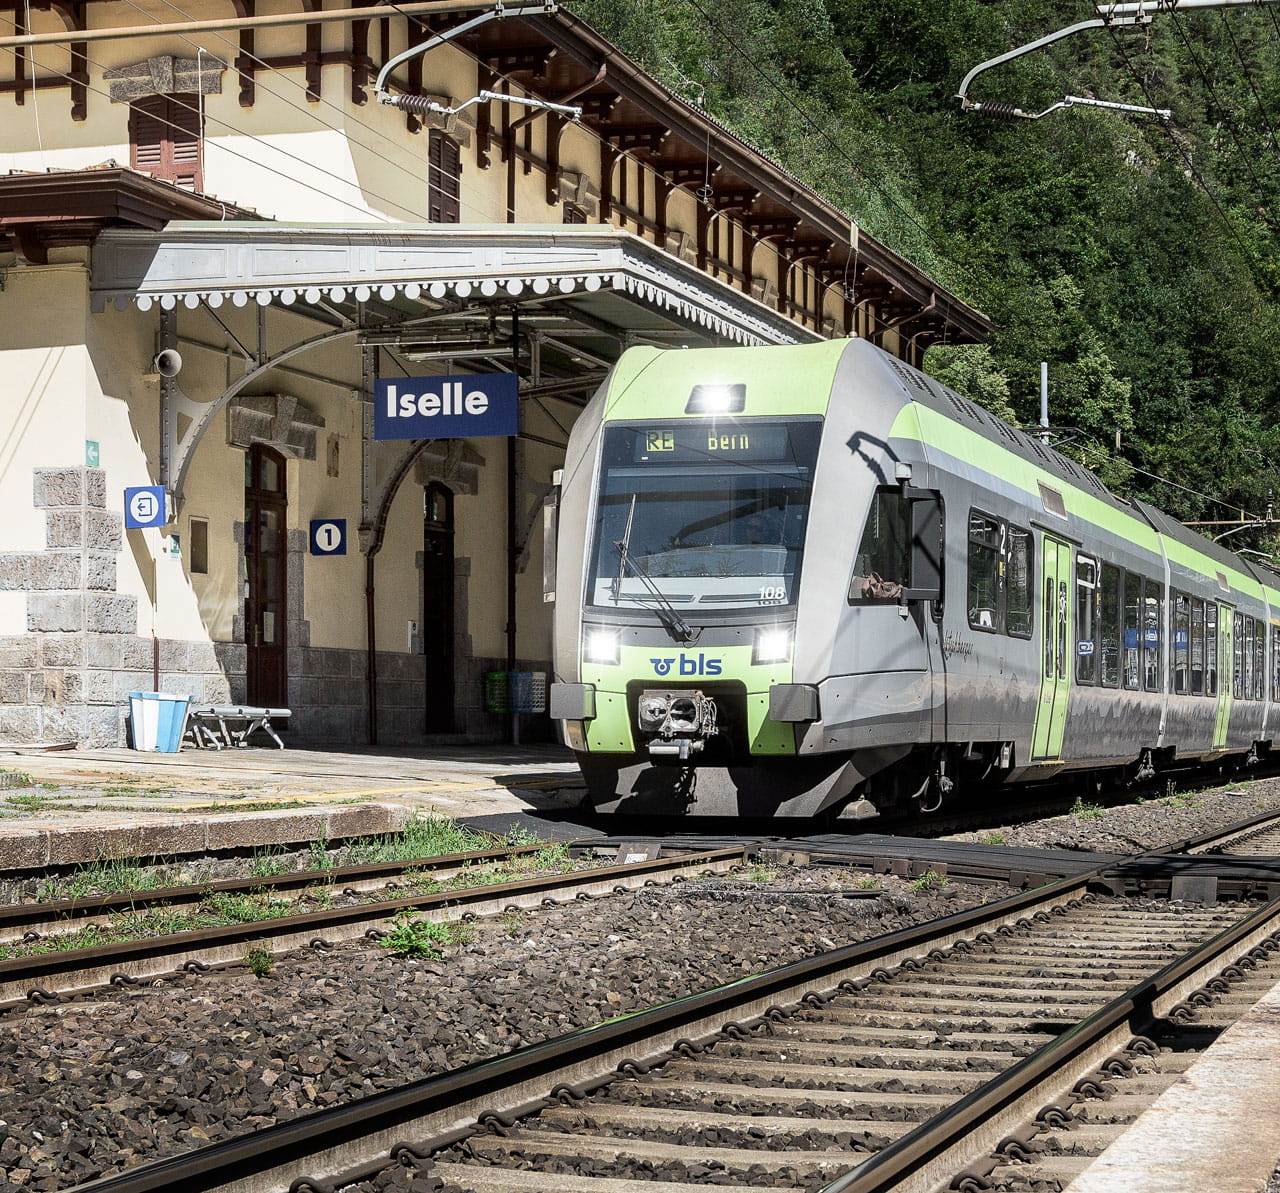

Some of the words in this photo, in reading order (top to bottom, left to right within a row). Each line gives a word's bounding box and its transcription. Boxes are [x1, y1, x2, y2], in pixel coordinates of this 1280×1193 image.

[386, 381, 489, 418] Iselle
[647, 430, 673, 450] RE
[324, 528, 332, 546] 1
[1000, 523, 1005, 555] 2
[758, 586, 785, 599] 108
[679, 653, 723, 676] bls
